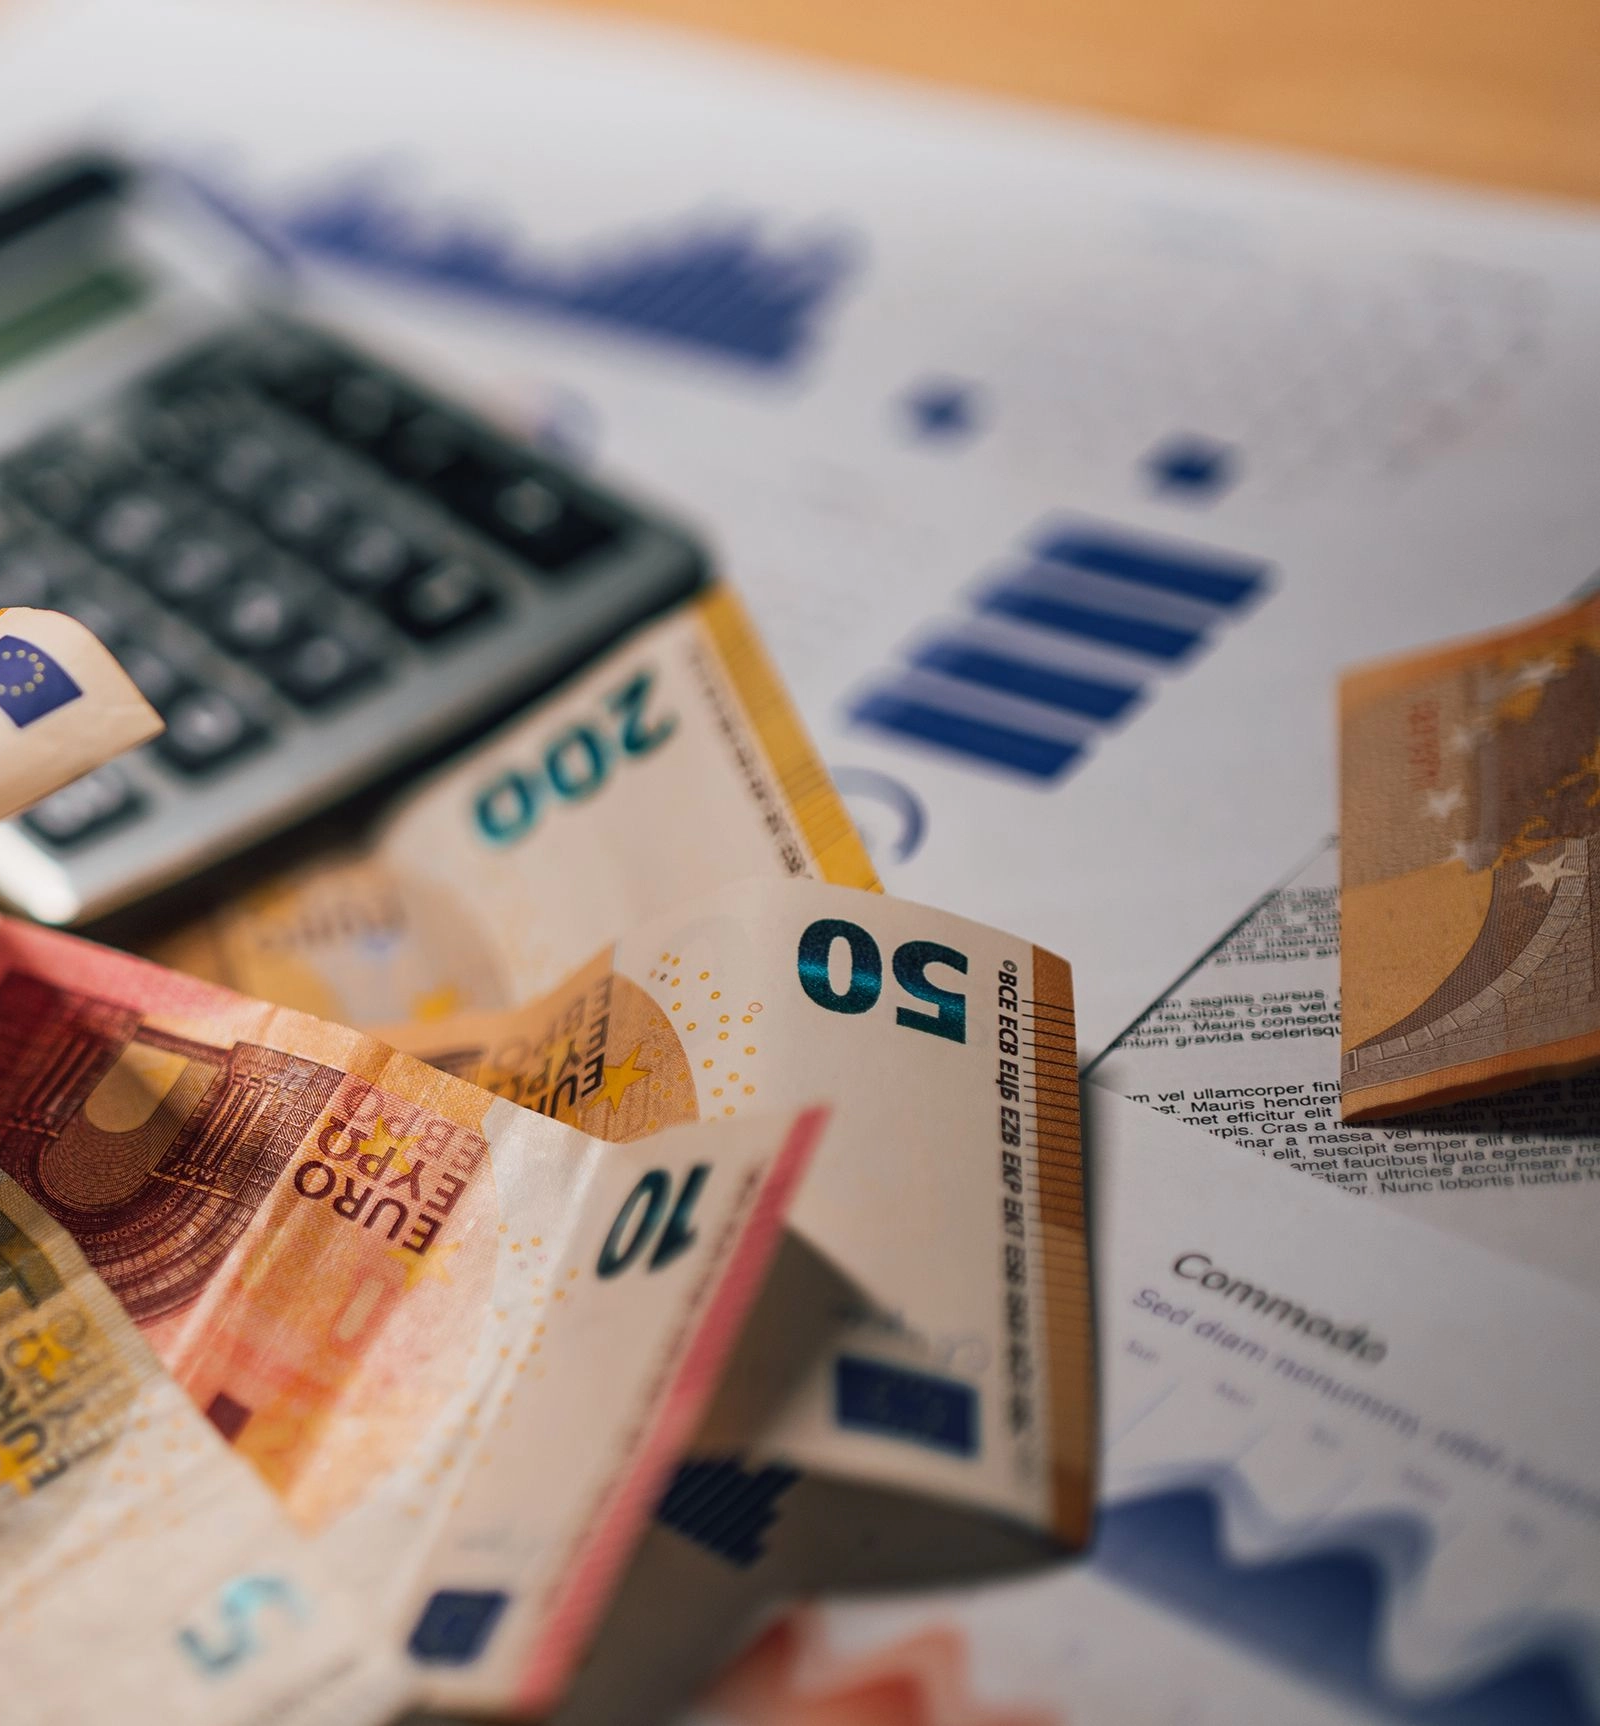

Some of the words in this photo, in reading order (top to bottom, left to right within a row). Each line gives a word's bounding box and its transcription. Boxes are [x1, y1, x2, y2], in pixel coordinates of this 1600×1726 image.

[473, 672, 680, 846] 200
[797, 918, 970, 1044] 50
[1247, 1003, 1293, 1017] Cras
[1300, 1000, 1327, 1012] vel
[998, 1014, 1018, 1057] ECB
[1193, 1017, 1256, 1032] Mauris
[1175, 1031, 1244, 1049] gravida
[1158, 1089, 1185, 1103] vel
[1193, 1084, 1305, 1101] ullamcorper
[1191, 1098, 1256, 1113] Mauris
[1000, 1105, 1021, 1148] EZB
[1227, 1110, 1296, 1124] efficitur
[1305, 1106, 1334, 1119] elit
[1261, 1121, 1309, 1135] Cras
[1315, 1120, 1328, 1132] a
[1273, 1147, 1307, 1161] elit,
[1314, 1142, 1387, 1158] suscipit
[1394, 1139, 1467, 1153] semper
[1475, 1134, 1505, 1148] elit
[1285, 1135, 1298, 1147] a
[1309, 1131, 1374, 1145] massa
[1383, 1126, 1413, 1140] vel
[1344, 1154, 1428, 1169] faucibus
[1433, 1150, 1486, 1165] ligula
[1492, 1145, 1573, 1161] egestas
[1002, 1150, 1023, 1195] EKP
[1376, 1166, 1454, 1181] ultricies
[1380, 1180, 1434, 1195] Nunc
[1440, 1175, 1515, 1191] lobortis
[1521, 1170, 1584, 1185] luctus
[294, 1160, 443, 1256] EURO
[596, 1161, 715, 1280] 10
[1172, 1252, 1389, 1366] Commodo
[1132, 1288, 1196, 1326] Sed
[1195, 1321, 1268, 1363] diam
